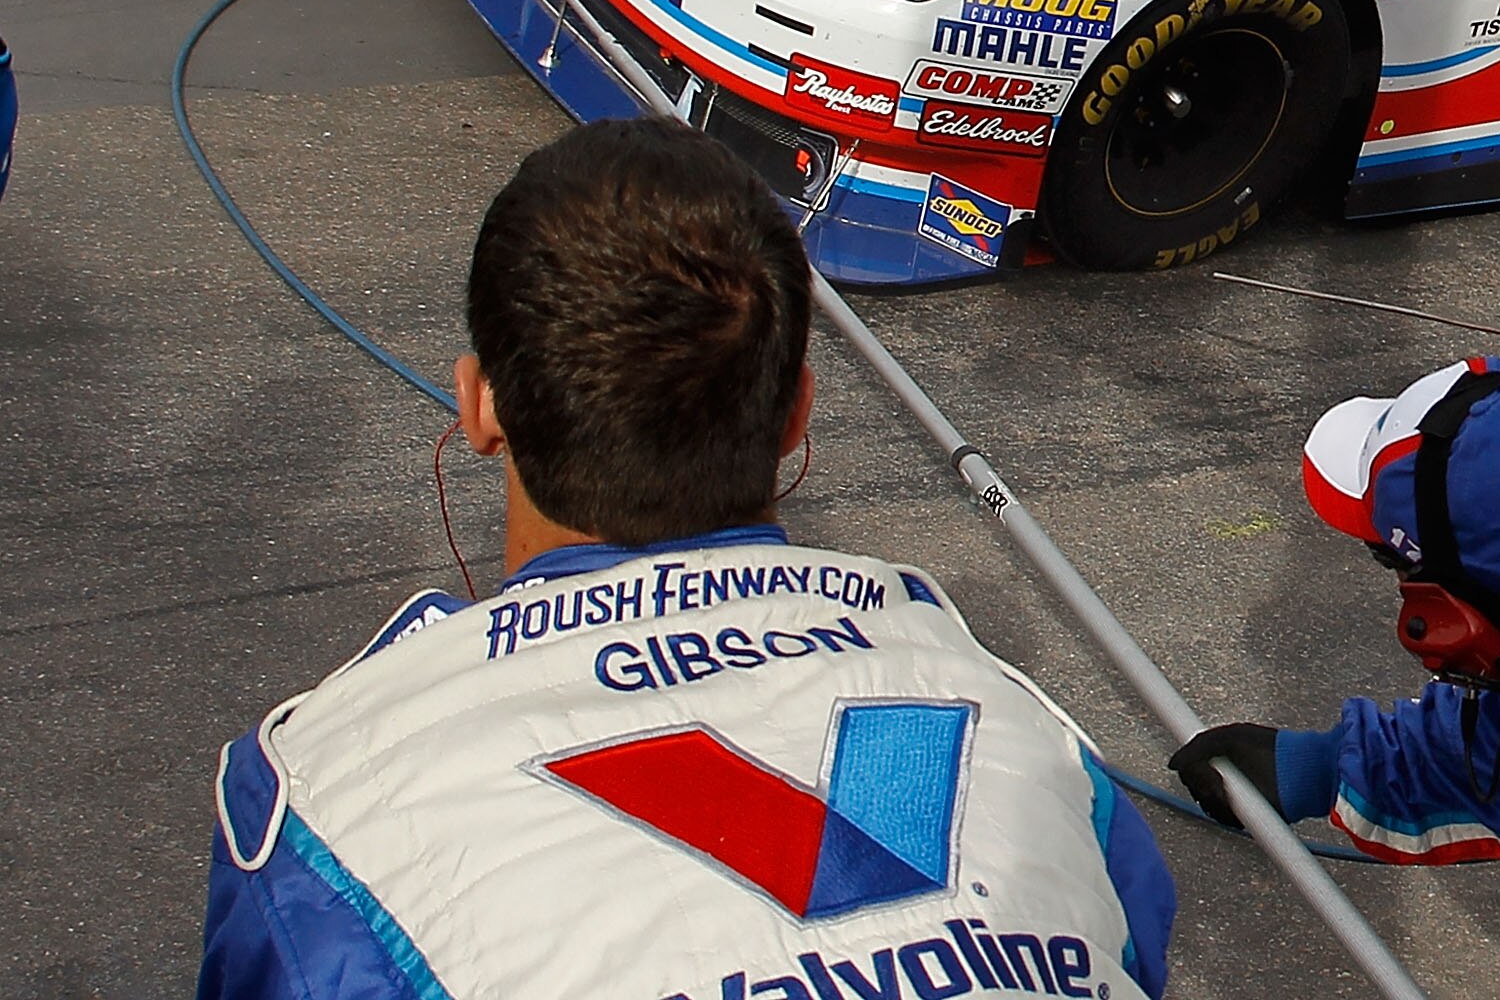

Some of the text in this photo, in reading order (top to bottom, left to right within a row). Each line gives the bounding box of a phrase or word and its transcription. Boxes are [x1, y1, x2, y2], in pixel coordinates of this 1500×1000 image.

[970, 6, 1106, 38] CHASSIS PARTS
[931, 17, 1088, 72] MAHLE
[792, 66, 896, 116] Raybestos
[916, 65, 1034, 101] COMP
[991, 96, 1048, 111] CAMS
[923, 109, 1049, 148] Edelbrock
[933, 197, 1001, 238] SUNOCO
[1153, 200, 1261, 271] EAGLE
[594, 616, 874, 693] GIBSON
